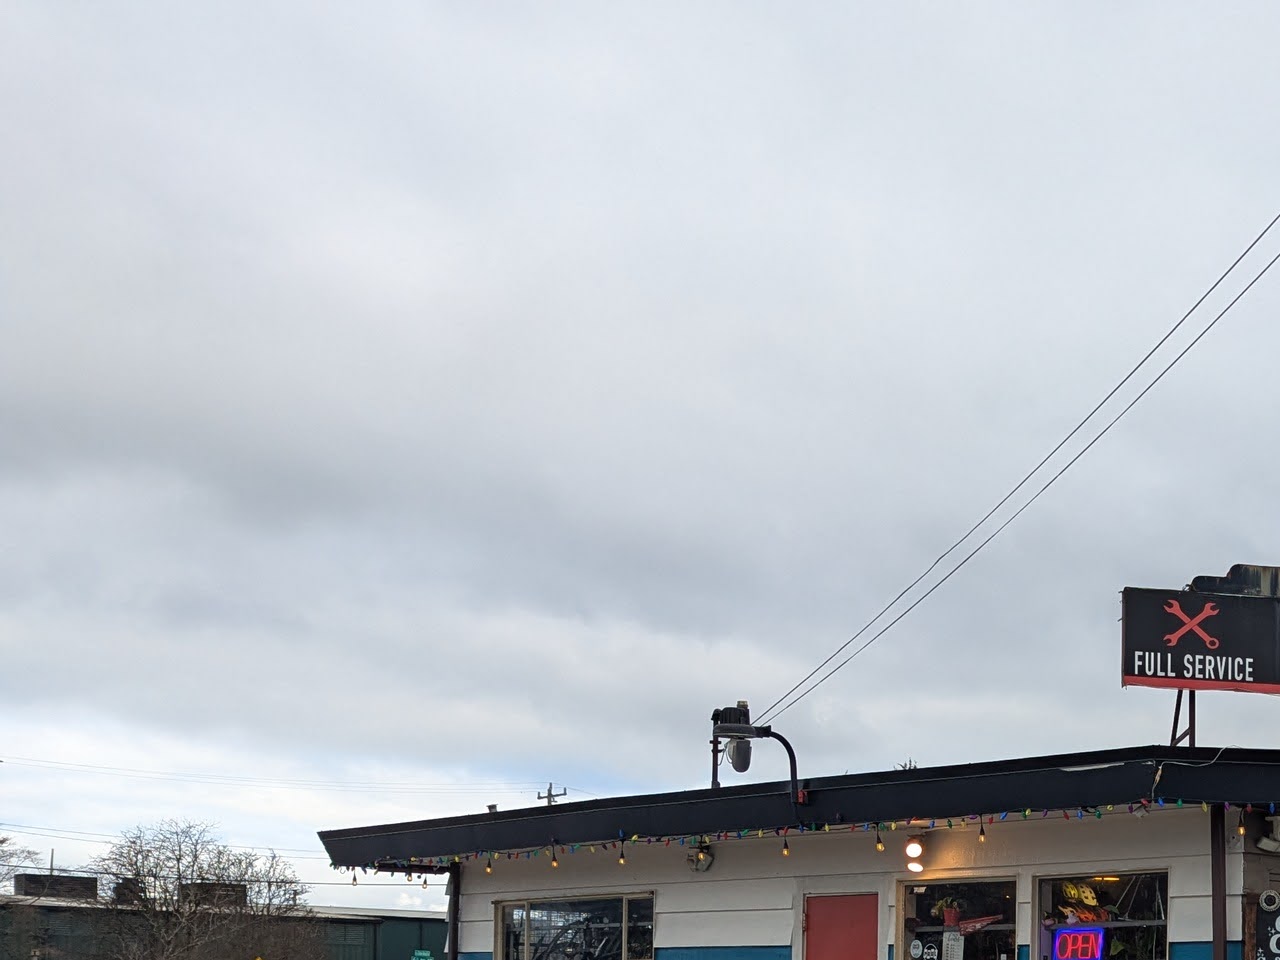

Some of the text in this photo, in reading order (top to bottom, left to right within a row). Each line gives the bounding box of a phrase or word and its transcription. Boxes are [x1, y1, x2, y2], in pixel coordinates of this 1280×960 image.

[1134, 651, 1254, 681] FULL SERVICE
[1058, 933, 1100, 959] OPEN
